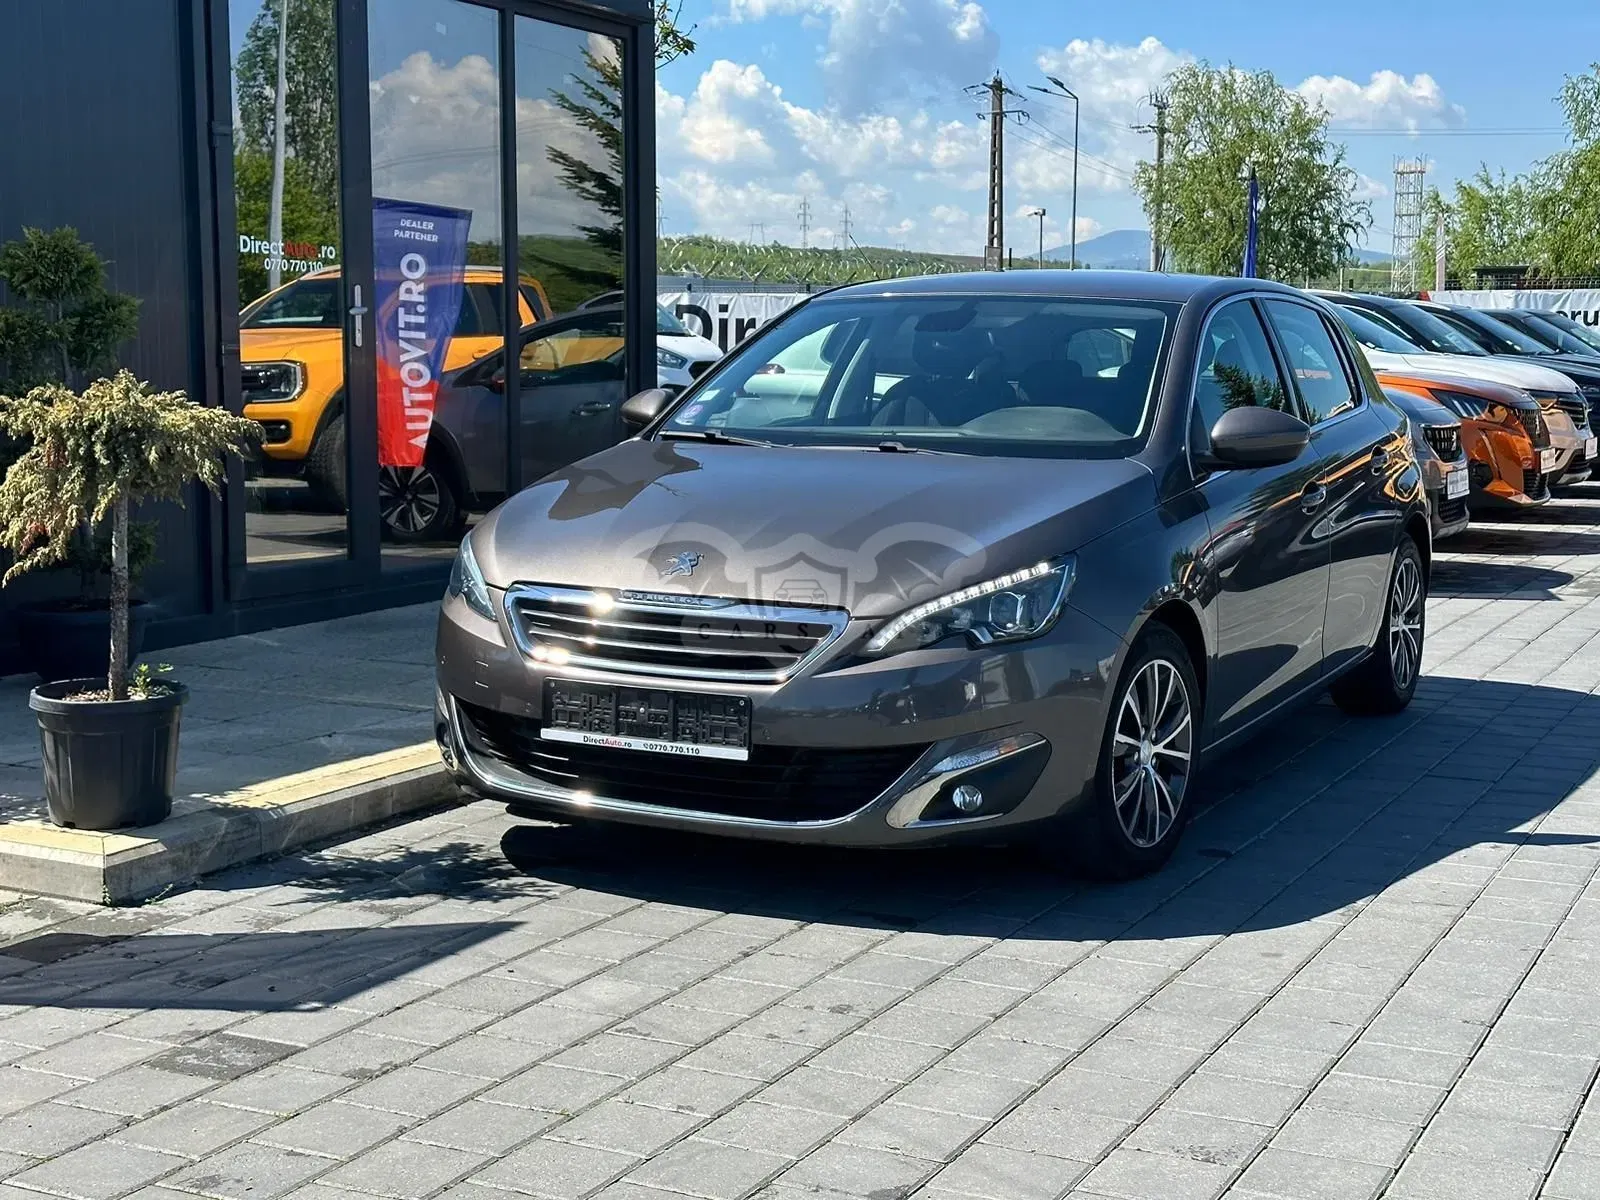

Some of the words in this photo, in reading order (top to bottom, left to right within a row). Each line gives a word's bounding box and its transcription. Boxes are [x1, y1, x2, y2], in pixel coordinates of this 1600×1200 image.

[400, 219, 434, 230] DEALER
[393, 229, 439, 242] PARTENER
[240, 235, 336, 259] DirectAuto.ro
[264, 257, 288, 272] 0770
[290, 259, 307, 272] 770
[308, 261, 323, 273] 110
[676, 303, 769, 355] Dir
[398, 253, 433, 449] AUTOVIT.RO
[583, 735, 632, 748] DirectAuto.ro
